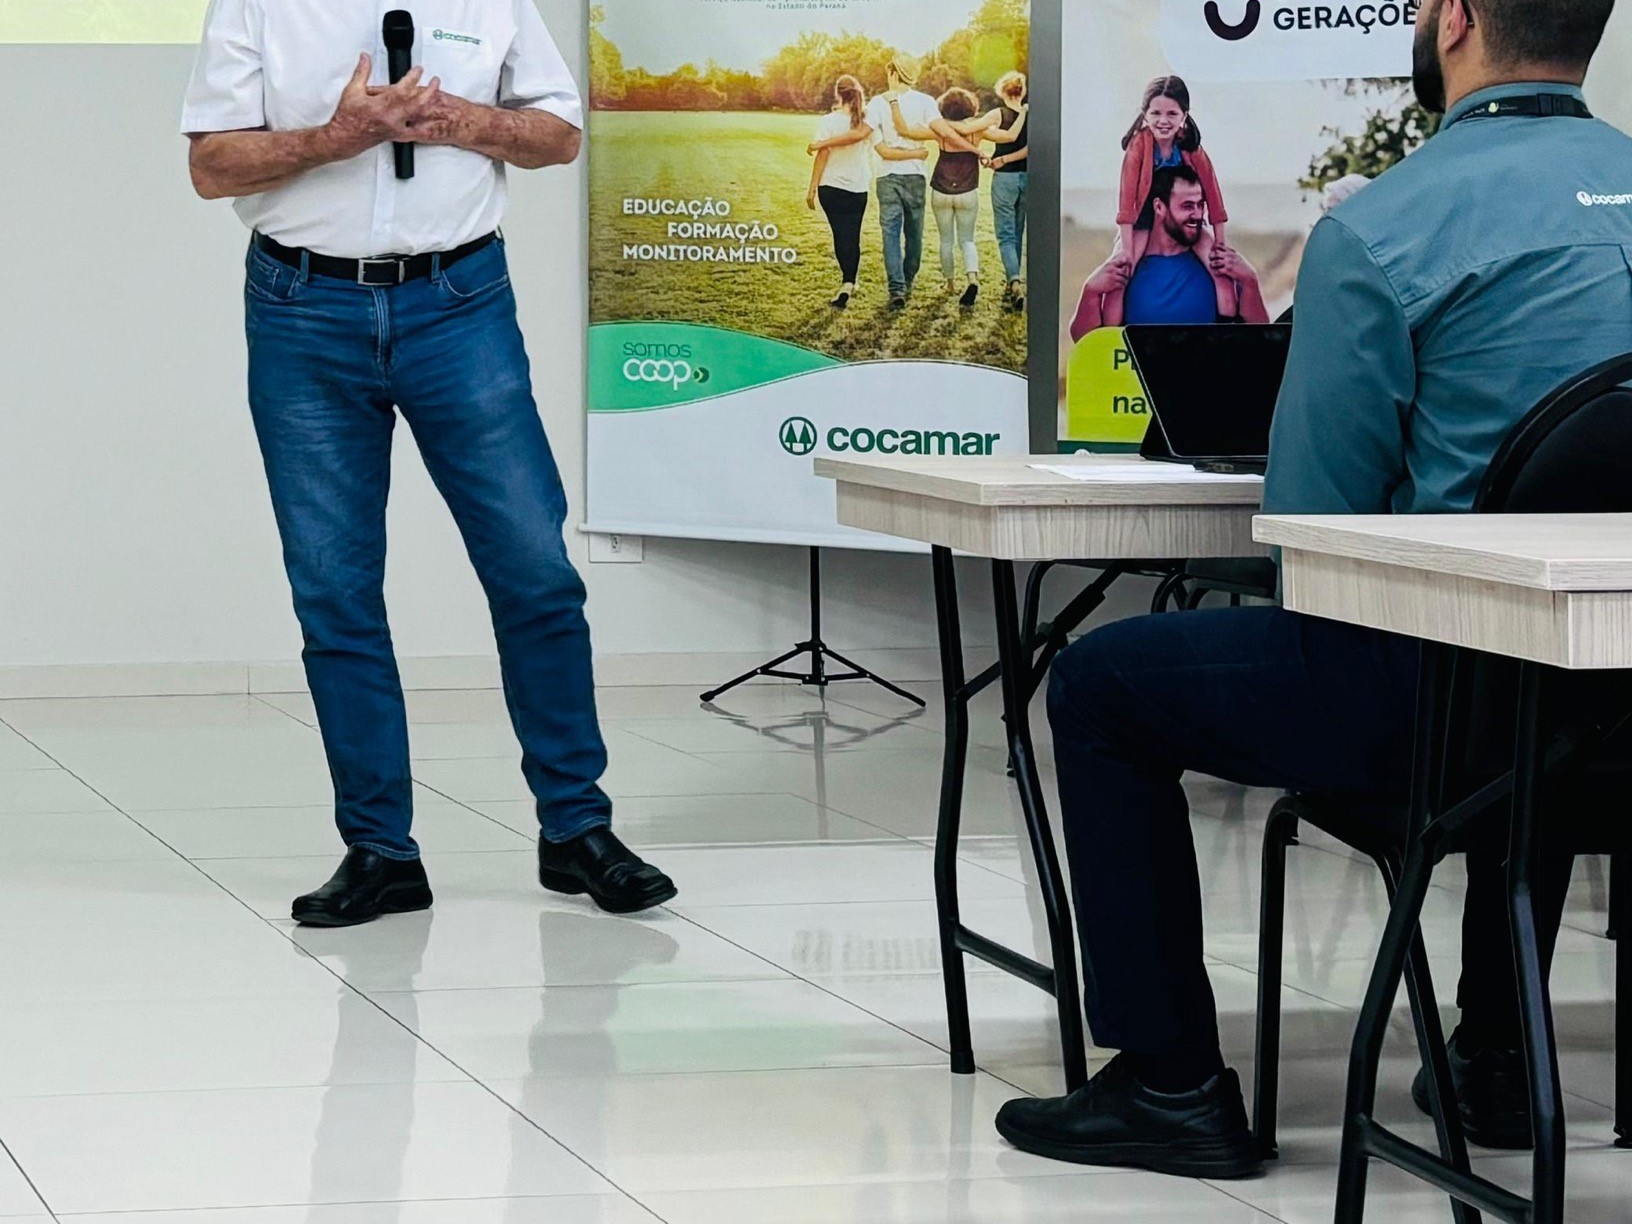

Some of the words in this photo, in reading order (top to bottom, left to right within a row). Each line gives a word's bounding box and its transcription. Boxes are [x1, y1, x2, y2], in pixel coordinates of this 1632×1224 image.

[622, 196, 731, 218] EDUCAÇÃO
[667, 219, 778, 241] FORMAÇÃO
[622, 243, 797, 264] MONITORAMENTO
[623, 342, 692, 358] somos
[1113, 348, 1136, 370] P
[623, 358, 691, 391] coop
[1113, 395, 1147, 414] na
[826, 426, 1001, 456] cocamar
